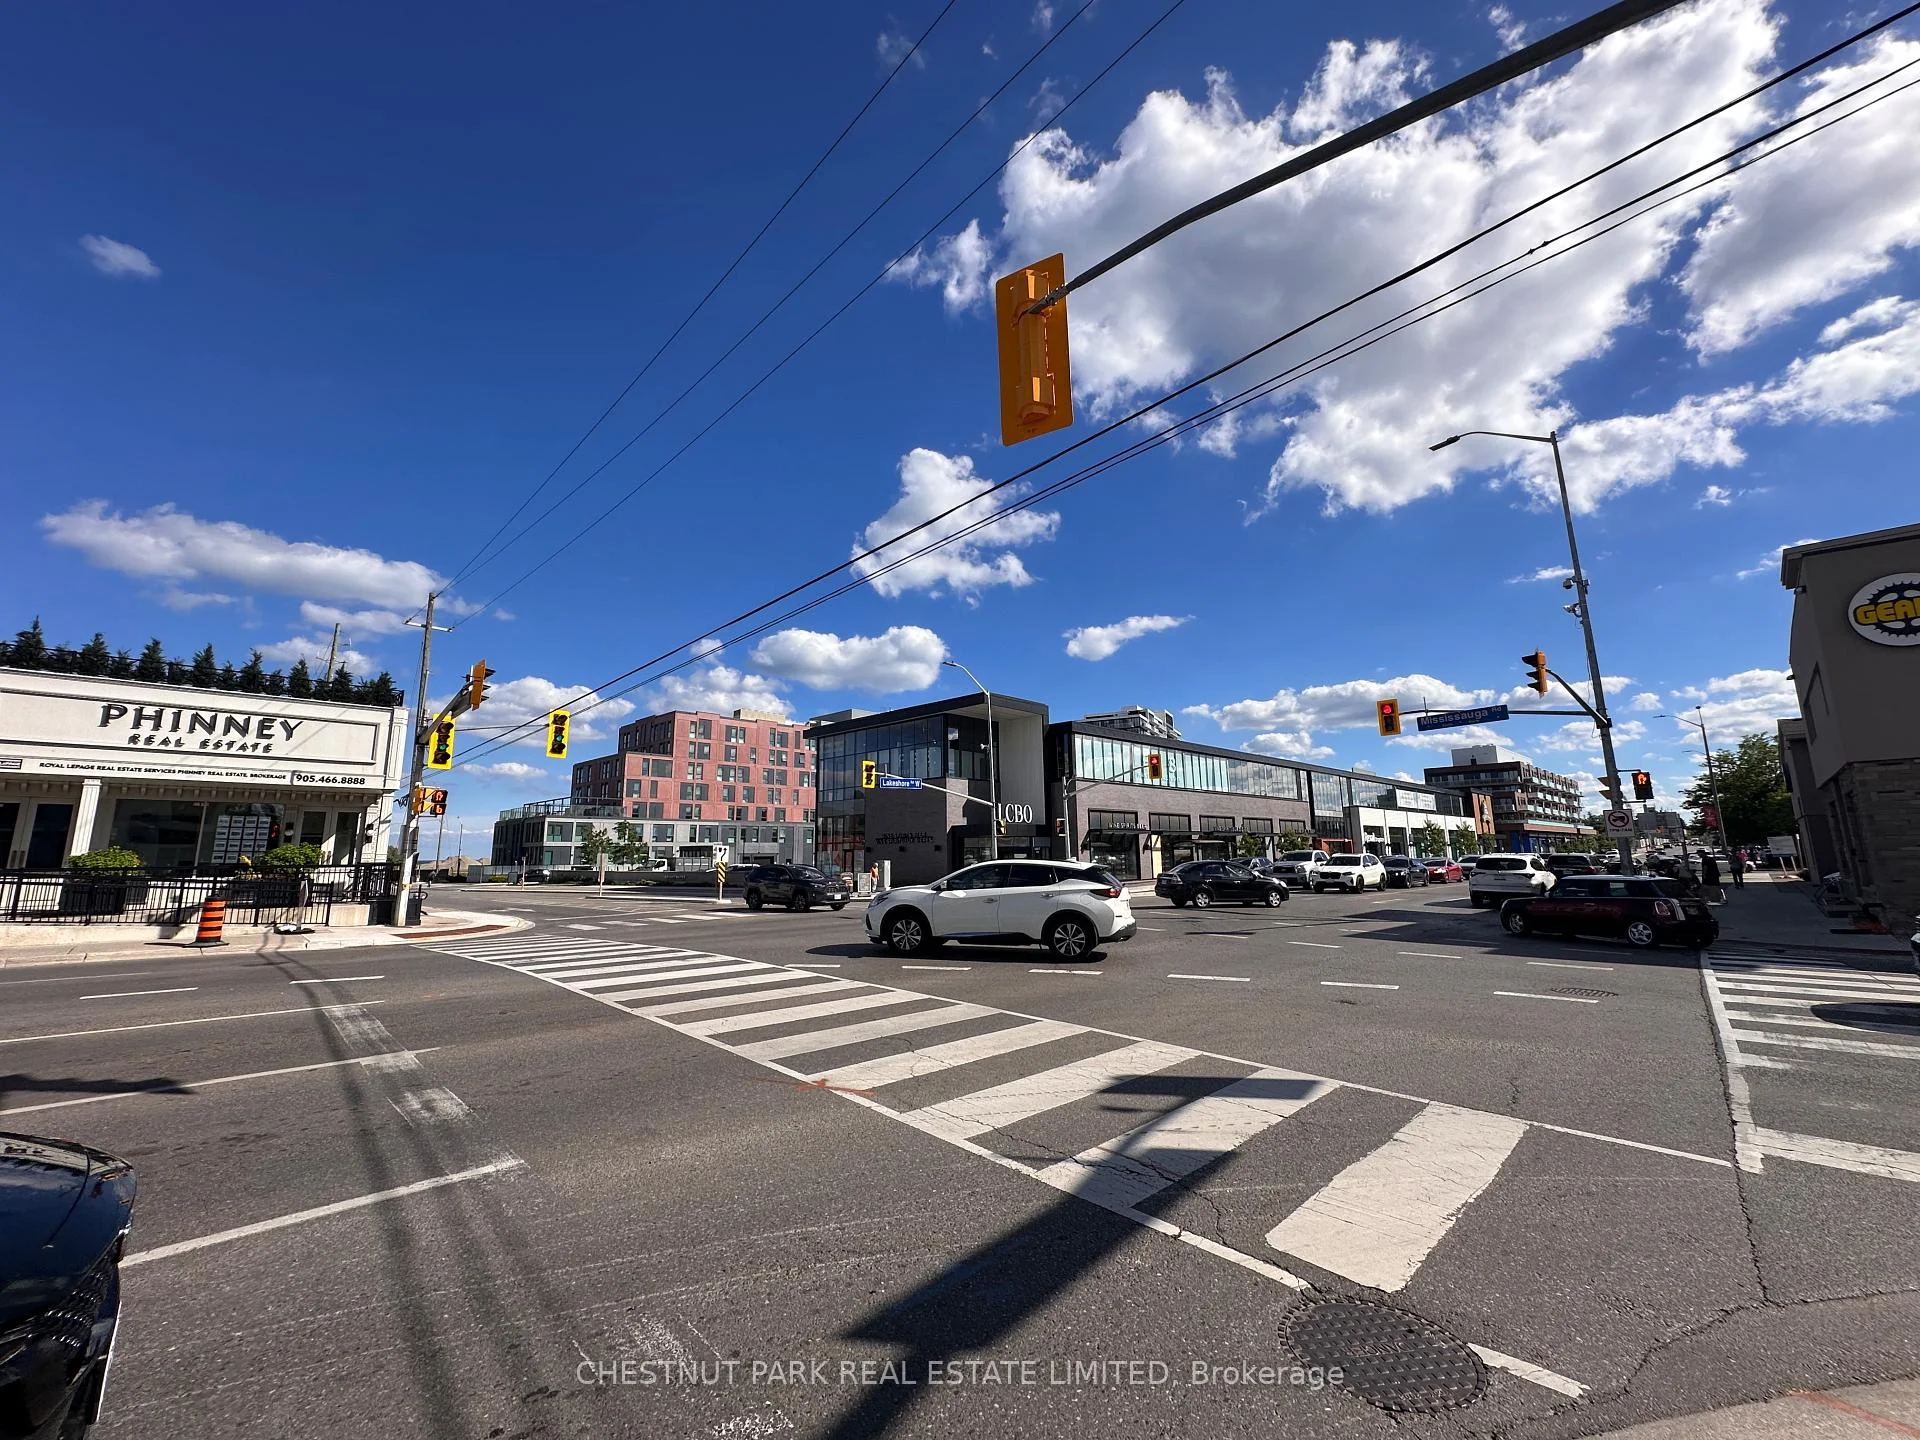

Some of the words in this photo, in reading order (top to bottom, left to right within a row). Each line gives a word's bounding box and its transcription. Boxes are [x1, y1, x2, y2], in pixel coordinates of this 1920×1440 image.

[98, 703, 304, 741] PHINNEY
[1421, 709, 1488, 725] Mississauga
[128, 733, 185, 748] REAL
[199, 738, 274, 754] ESTATE
[296, 774, 366, 785] 905.466.8888
[882, 779, 910, 788] Lakeshore
[915, 780, 921, 788] W
